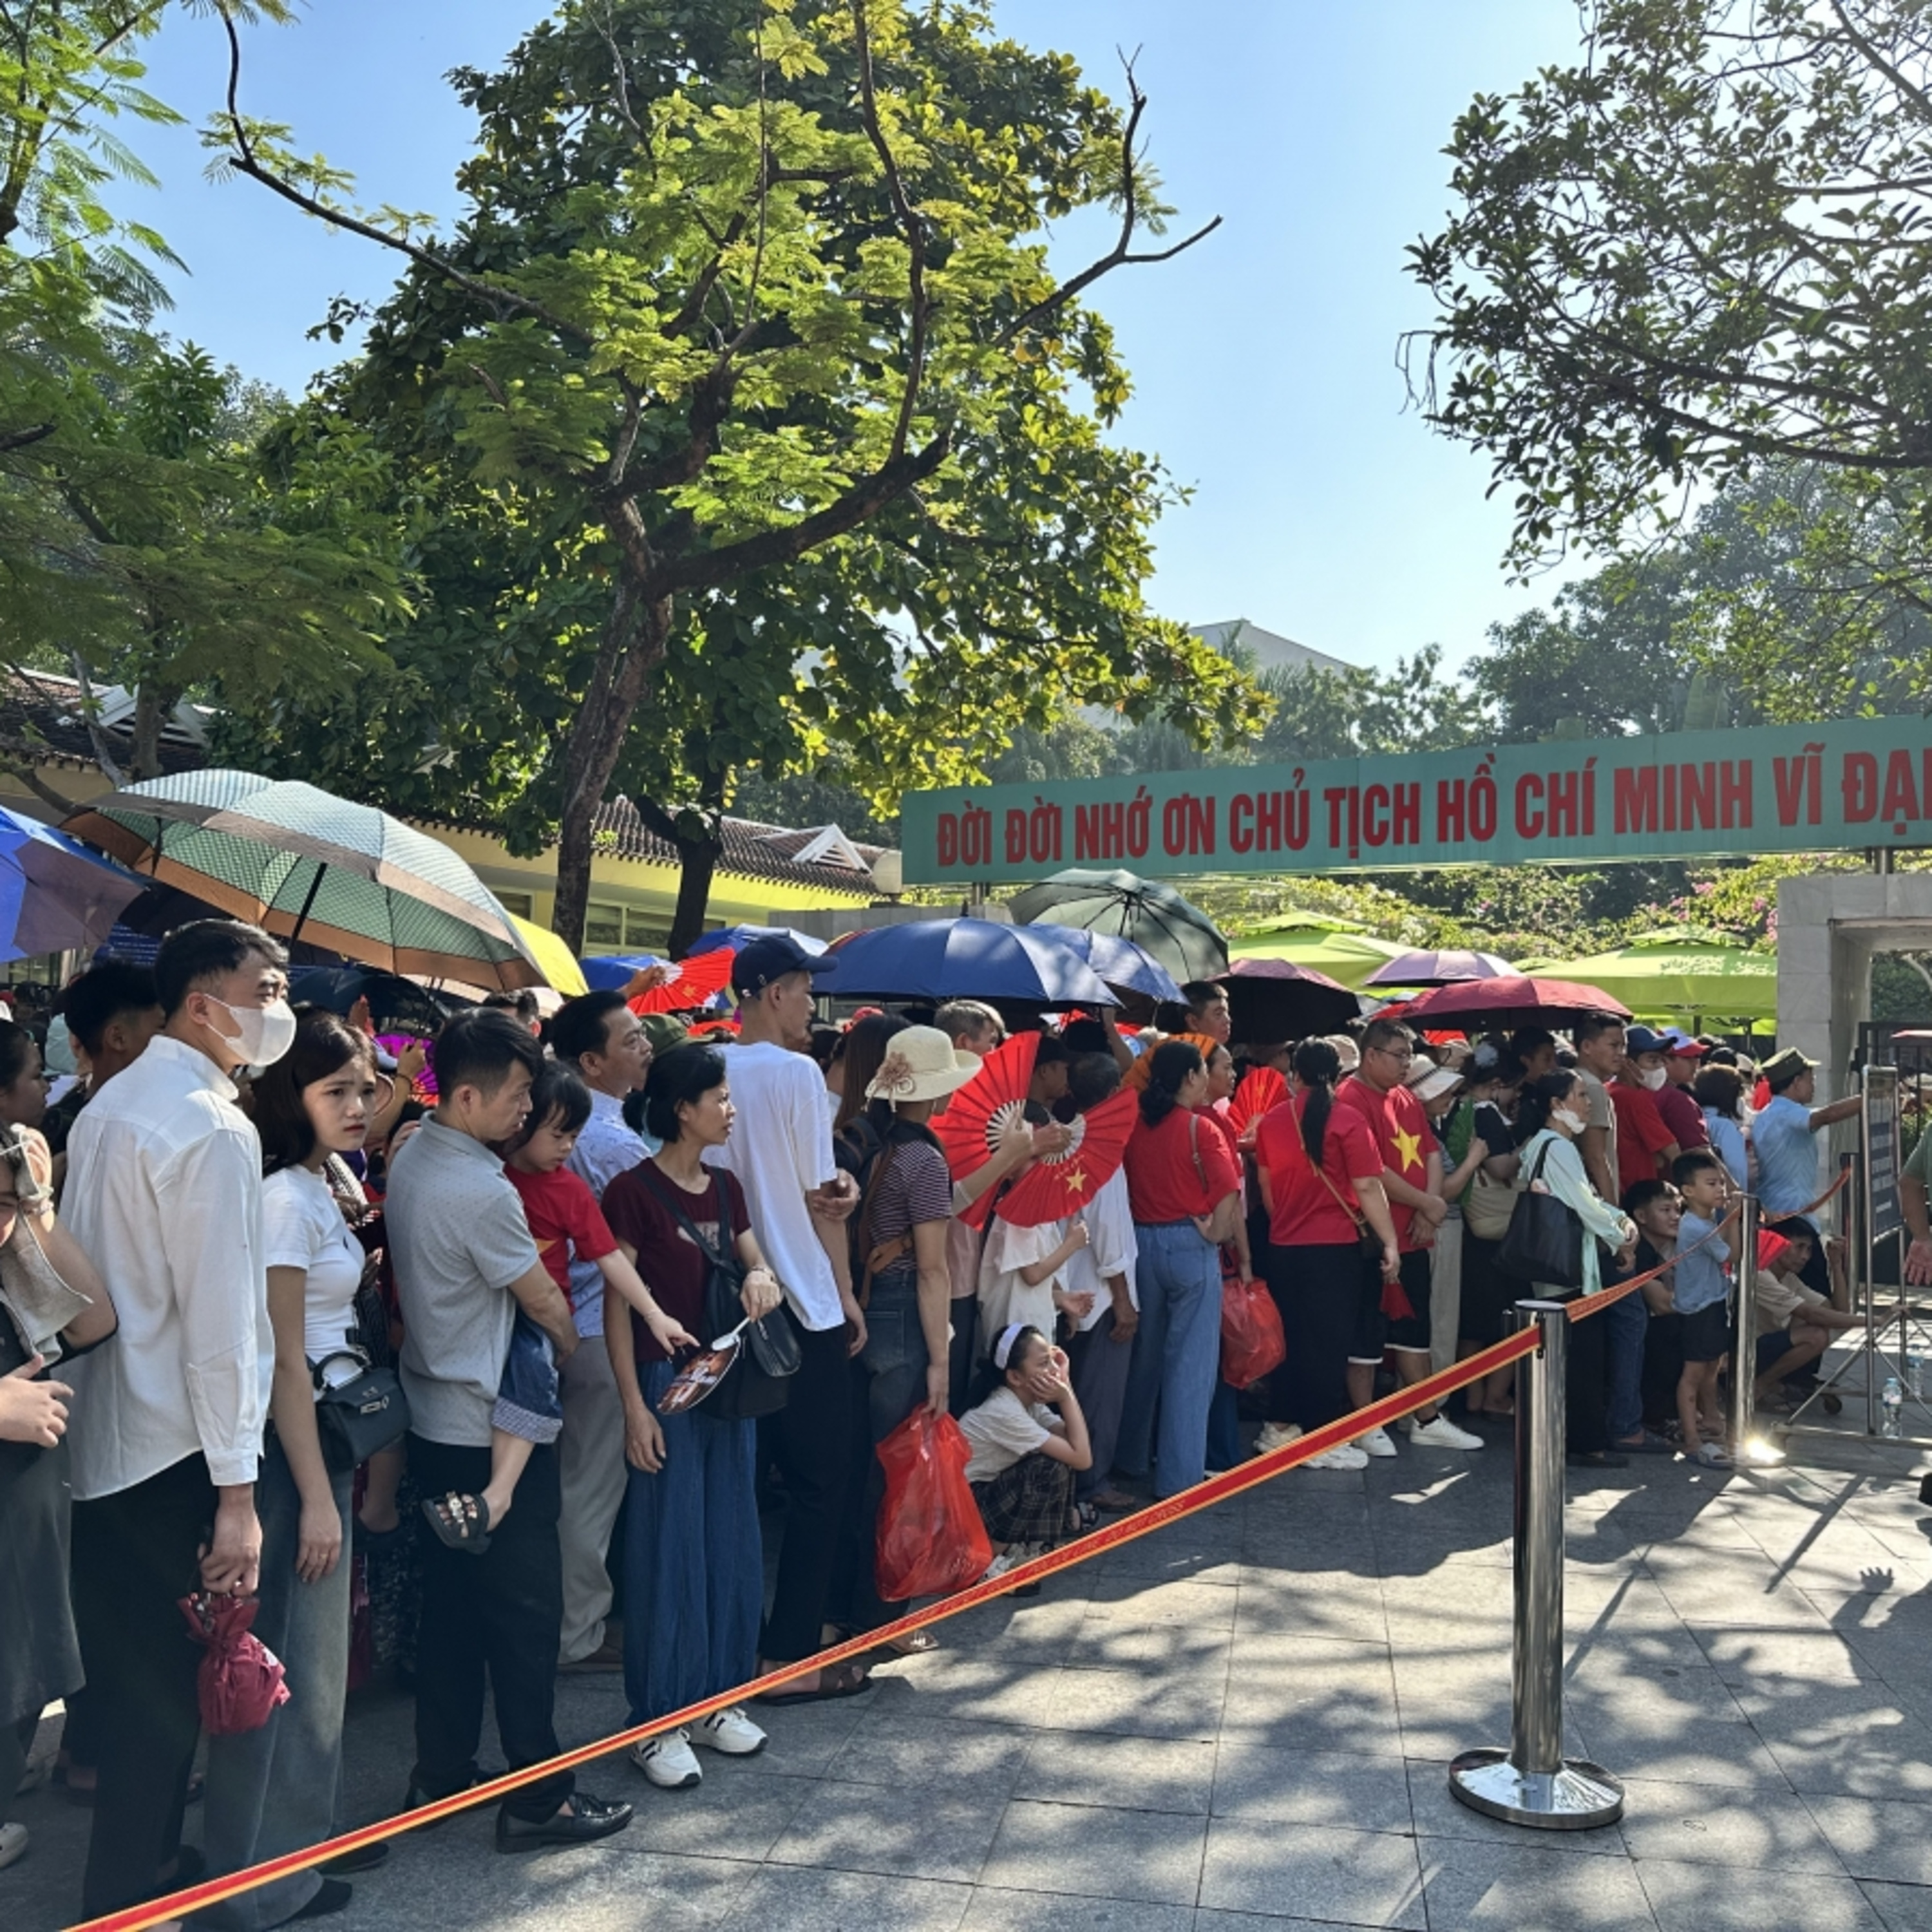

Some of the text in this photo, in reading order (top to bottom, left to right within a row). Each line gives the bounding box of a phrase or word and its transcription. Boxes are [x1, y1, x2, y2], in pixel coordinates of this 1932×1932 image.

[937, 800, 991, 866] ĐỜI
[1005, 796, 1062, 864] ĐỜI
[1075, 785, 1153, 860] NHỚ
[1163, 793, 1215, 857] ƠN
[1229, 768, 1310, 854] CHỦ
[1323, 783, 1421, 860] TỊCH
[1437, 753, 1497, 843] HỒ
[1515, 757, 1598, 839] CHÍ
[1614, 759, 1752, 834] MINH
[1772, 743, 1825, 827] VĨ
